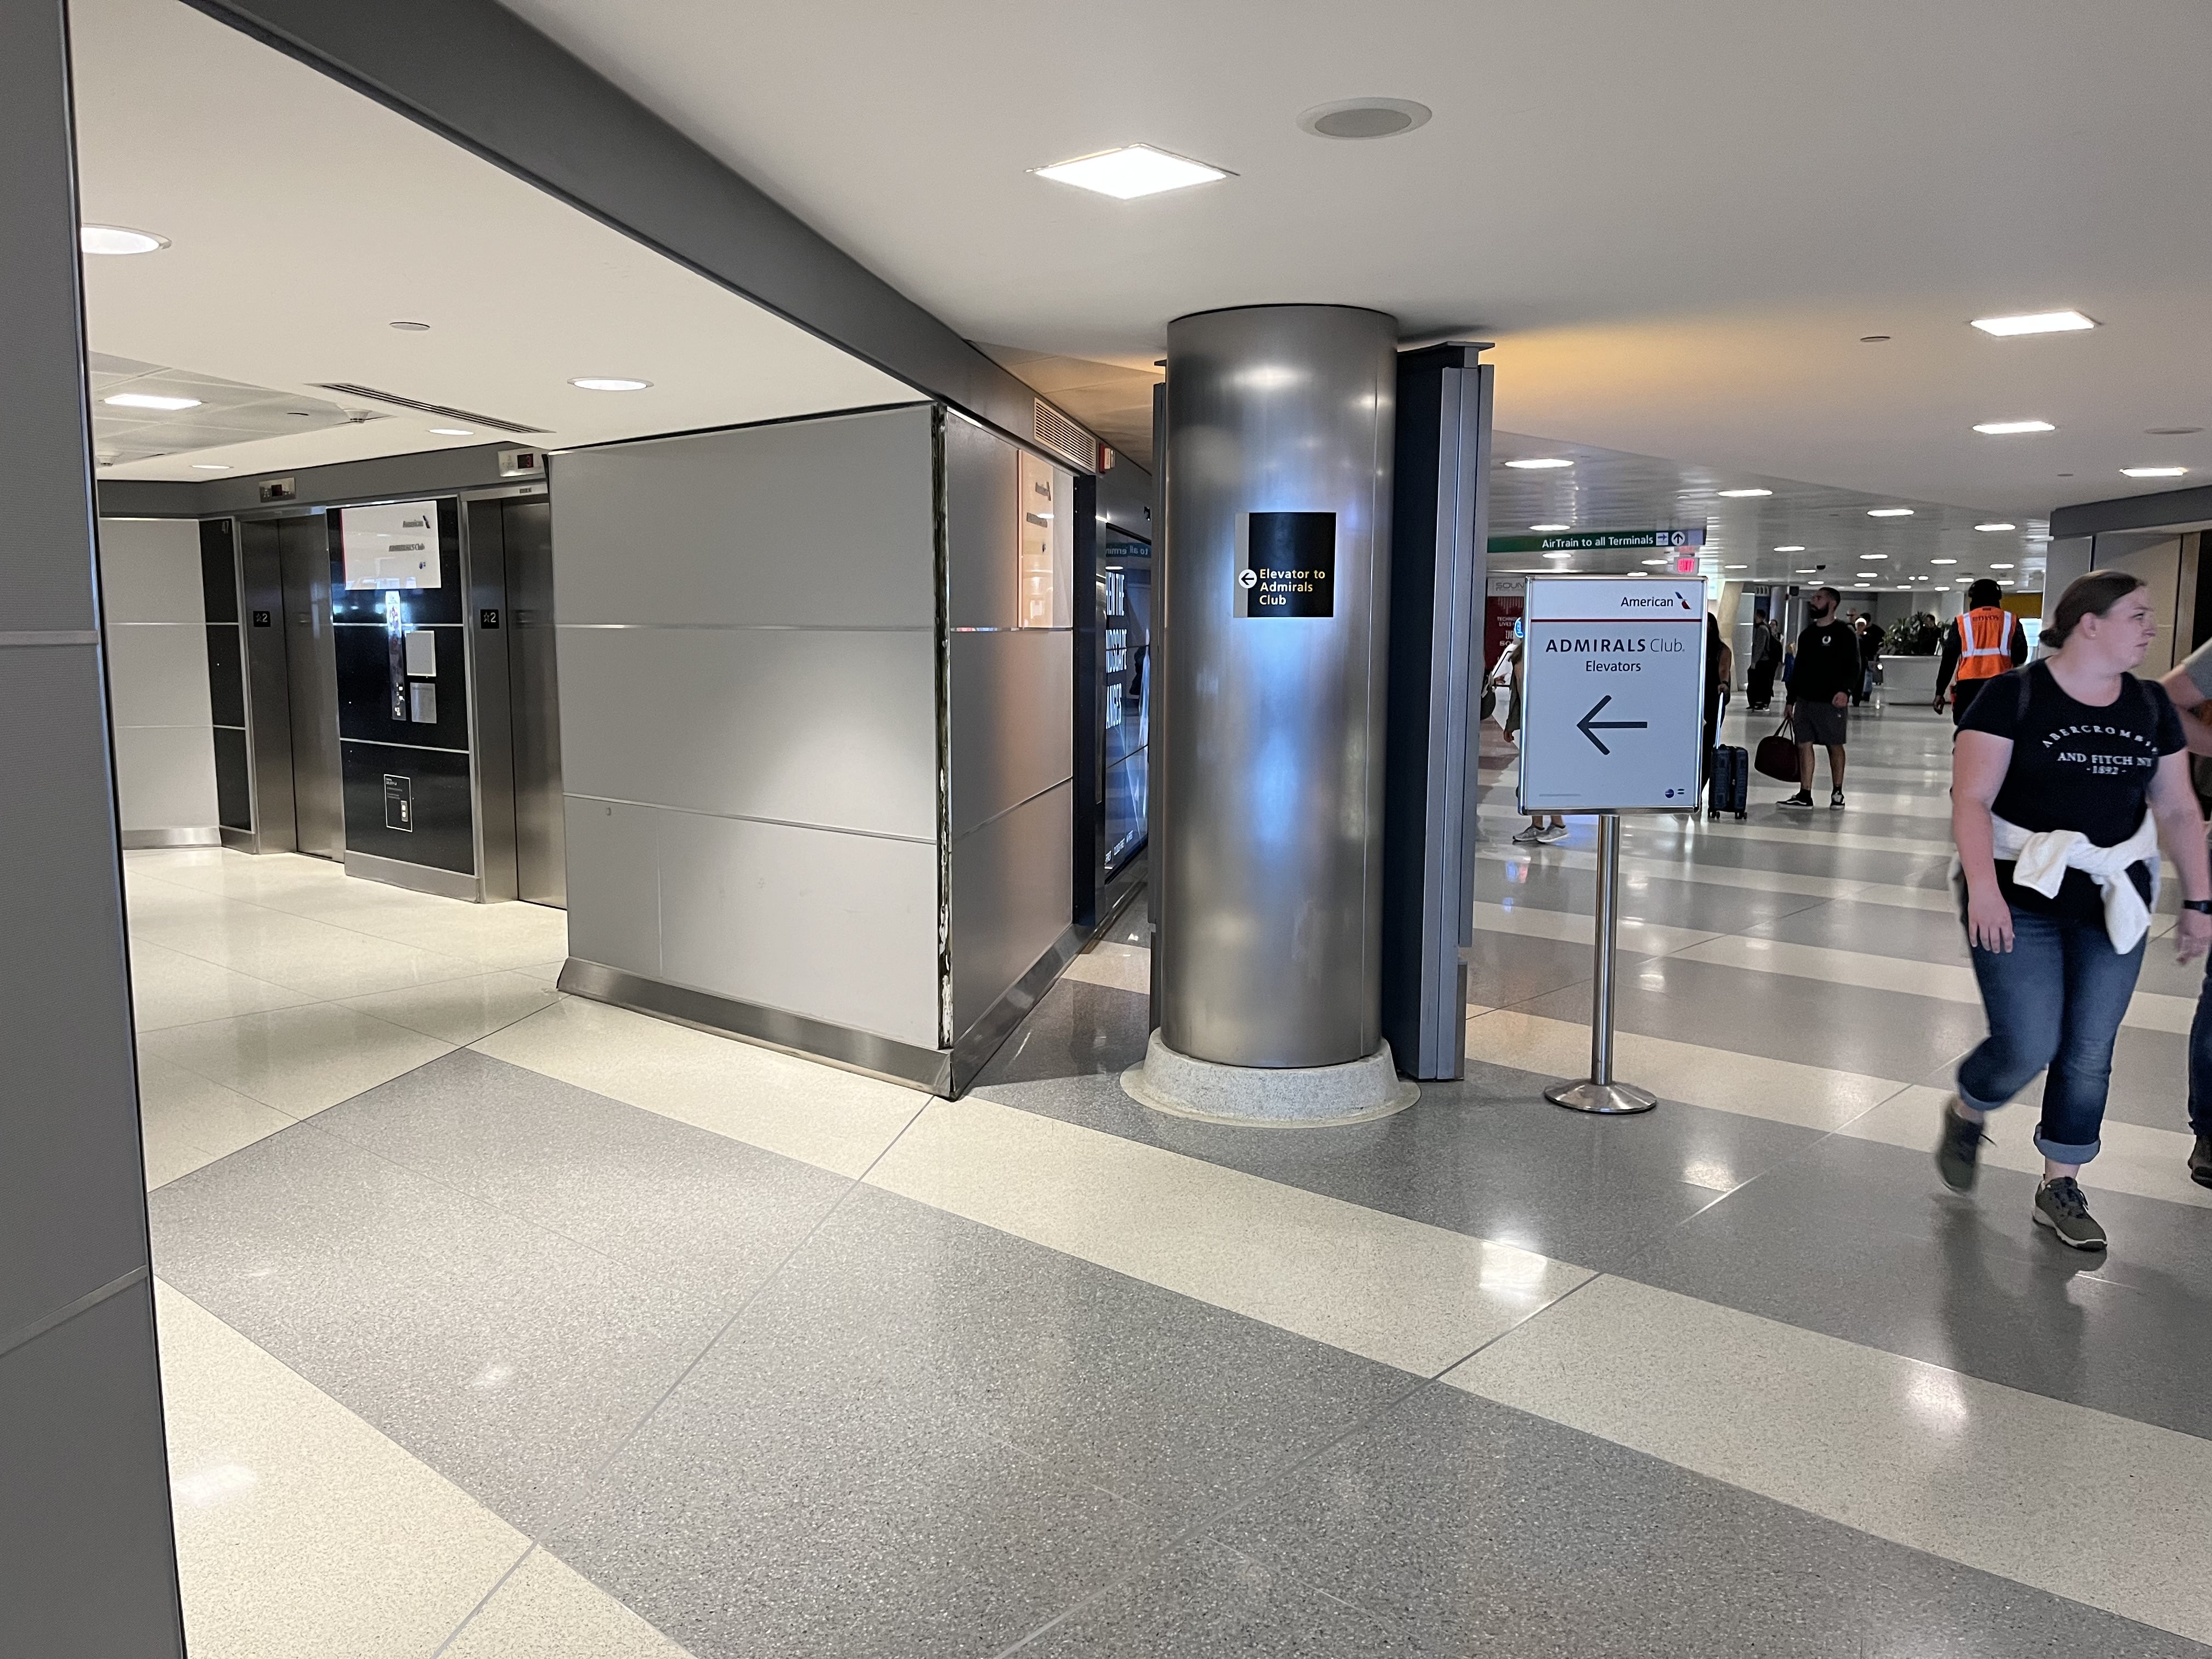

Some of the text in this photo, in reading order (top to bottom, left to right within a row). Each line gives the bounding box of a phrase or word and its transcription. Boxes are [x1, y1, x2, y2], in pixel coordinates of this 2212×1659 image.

[1542, 535, 1654, 549] AirTrain to all Terminals
[1259, 568, 1325, 579] Elevator to
[1260, 582, 1313, 592] Admirals
[1259, 594, 1286, 605] Club
[1621, 596, 1673, 607] American
[262, 613, 268, 623] 2
[490, 612, 496, 623] 2
[1545, 639, 1646, 652] ADMIRALS
[1585, 661, 1641, 672] Elevators
[2057, 752, 2087, 763] AND
[2091, 754, 2134, 765] FITCH
